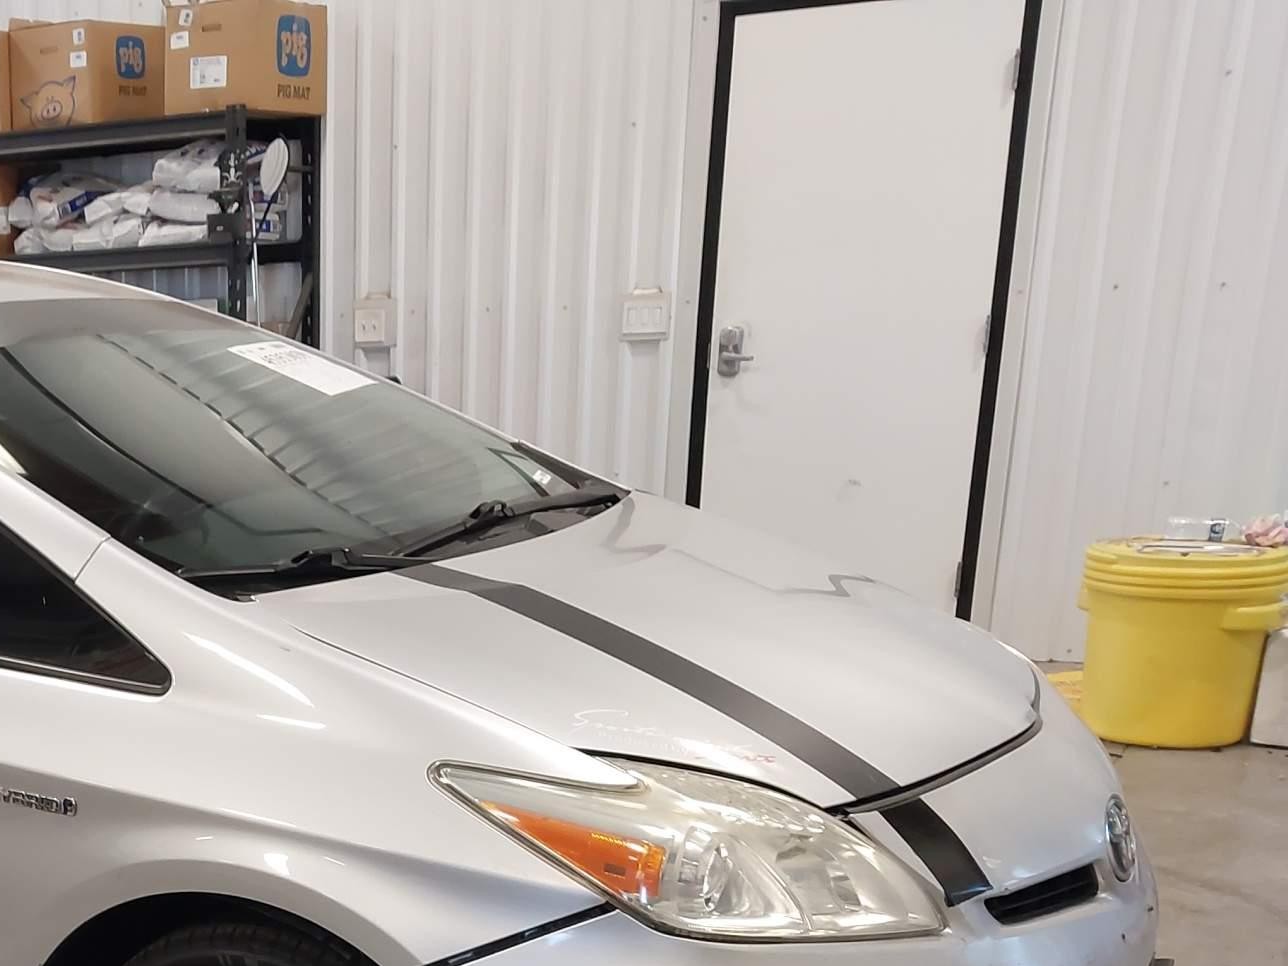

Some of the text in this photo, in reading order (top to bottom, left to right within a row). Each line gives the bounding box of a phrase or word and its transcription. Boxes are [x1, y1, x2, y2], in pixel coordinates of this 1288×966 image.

[281, 21, 308, 69] pig
[119, 41, 143, 74] pig
[118, 85, 147, 97] PIG MAT
[277, 84, 311, 100] PIG MAT
